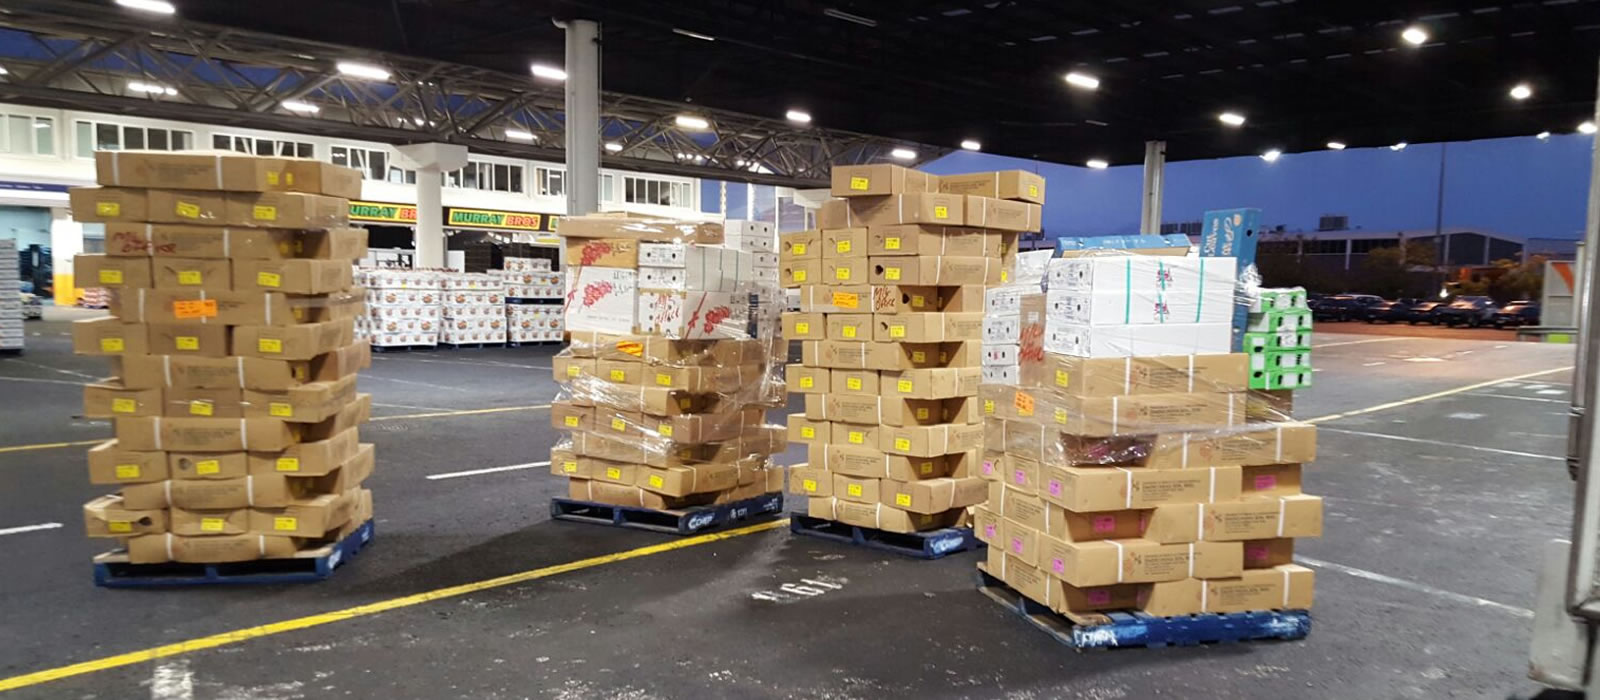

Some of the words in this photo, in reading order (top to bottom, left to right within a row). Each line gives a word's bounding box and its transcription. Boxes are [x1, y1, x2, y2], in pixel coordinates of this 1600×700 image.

[350, 205, 398, 219] URRAY
[400, 207, 417, 220] BR
[453, 211, 505, 225] MURRAY
[506, 215, 537, 227] BROS
